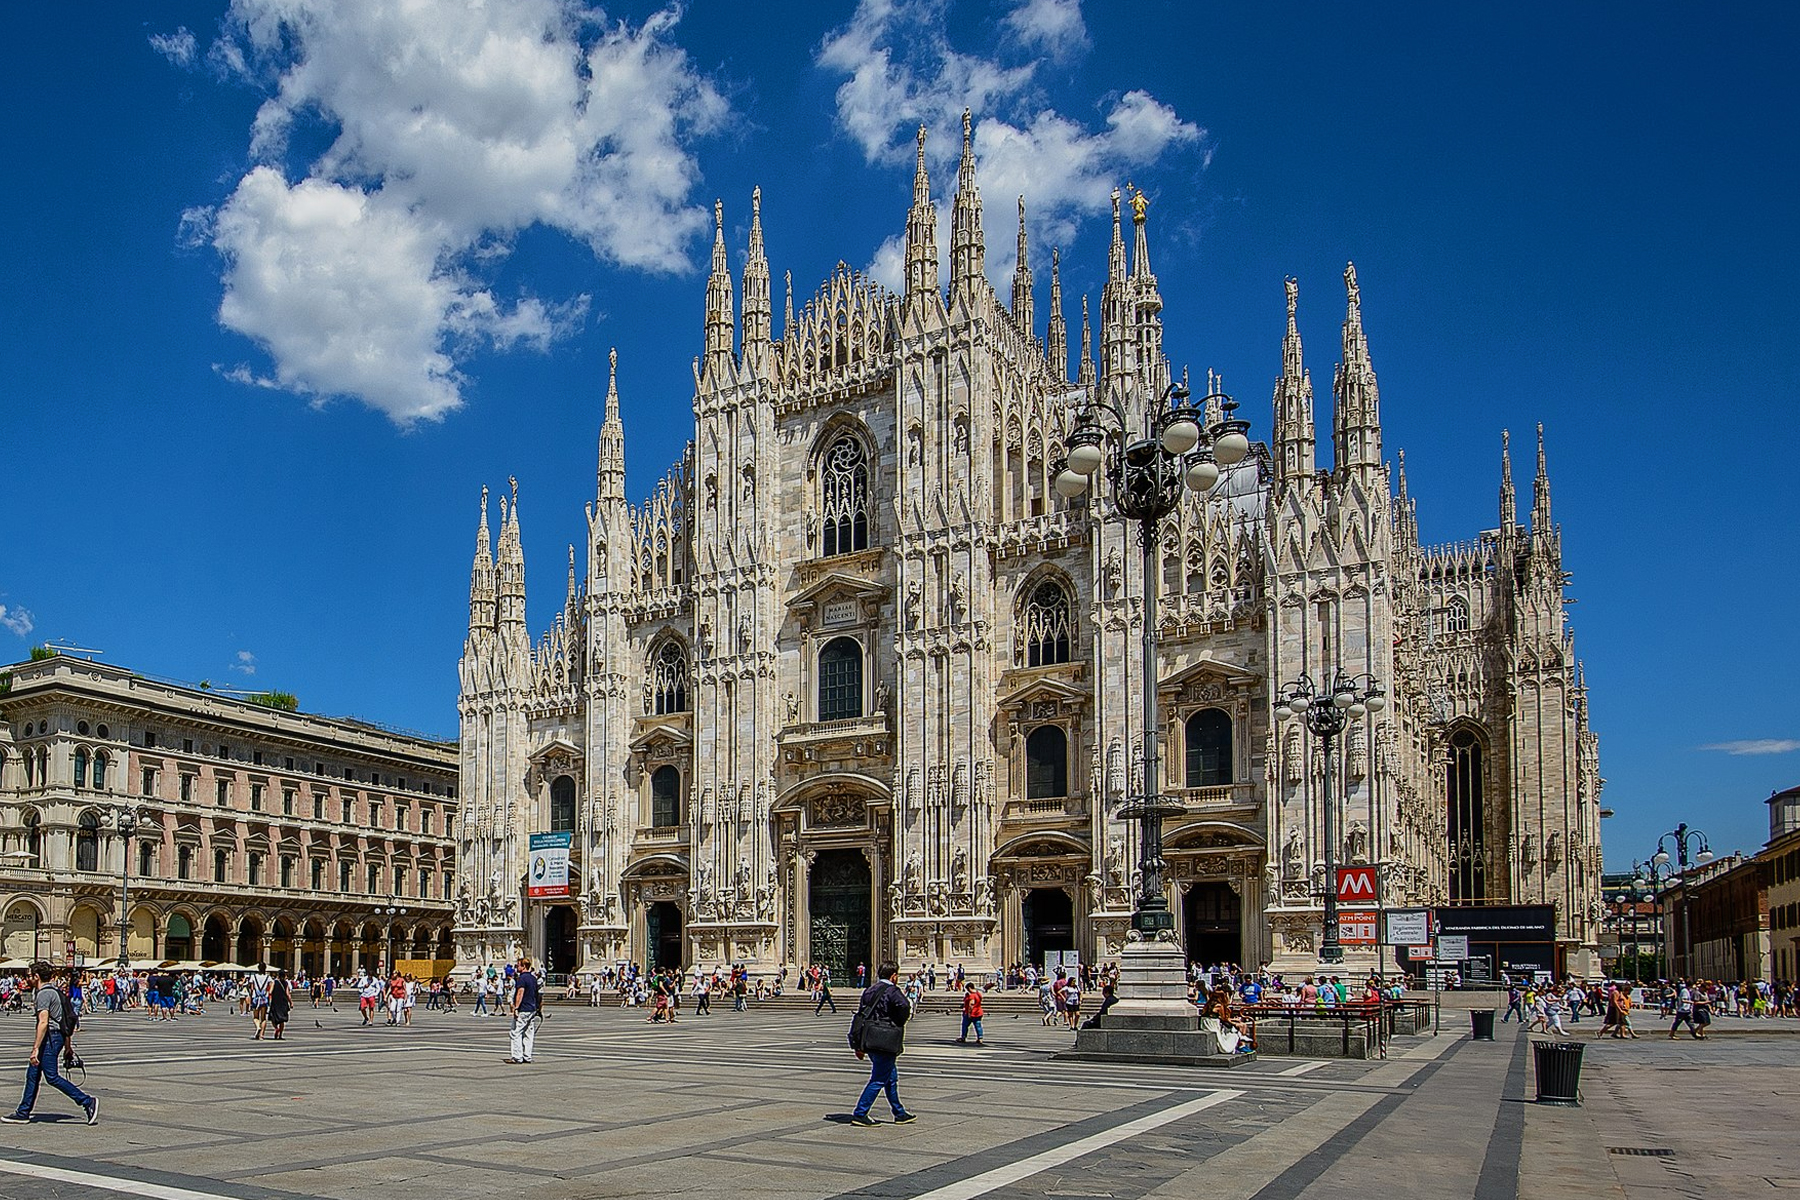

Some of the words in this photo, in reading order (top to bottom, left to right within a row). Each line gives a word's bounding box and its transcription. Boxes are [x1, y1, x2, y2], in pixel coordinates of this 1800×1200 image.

[829, 604, 852, 612] MARIAE
[826, 612, 855, 620] NASCENTI
[1340, 873, 1373, 894] M
